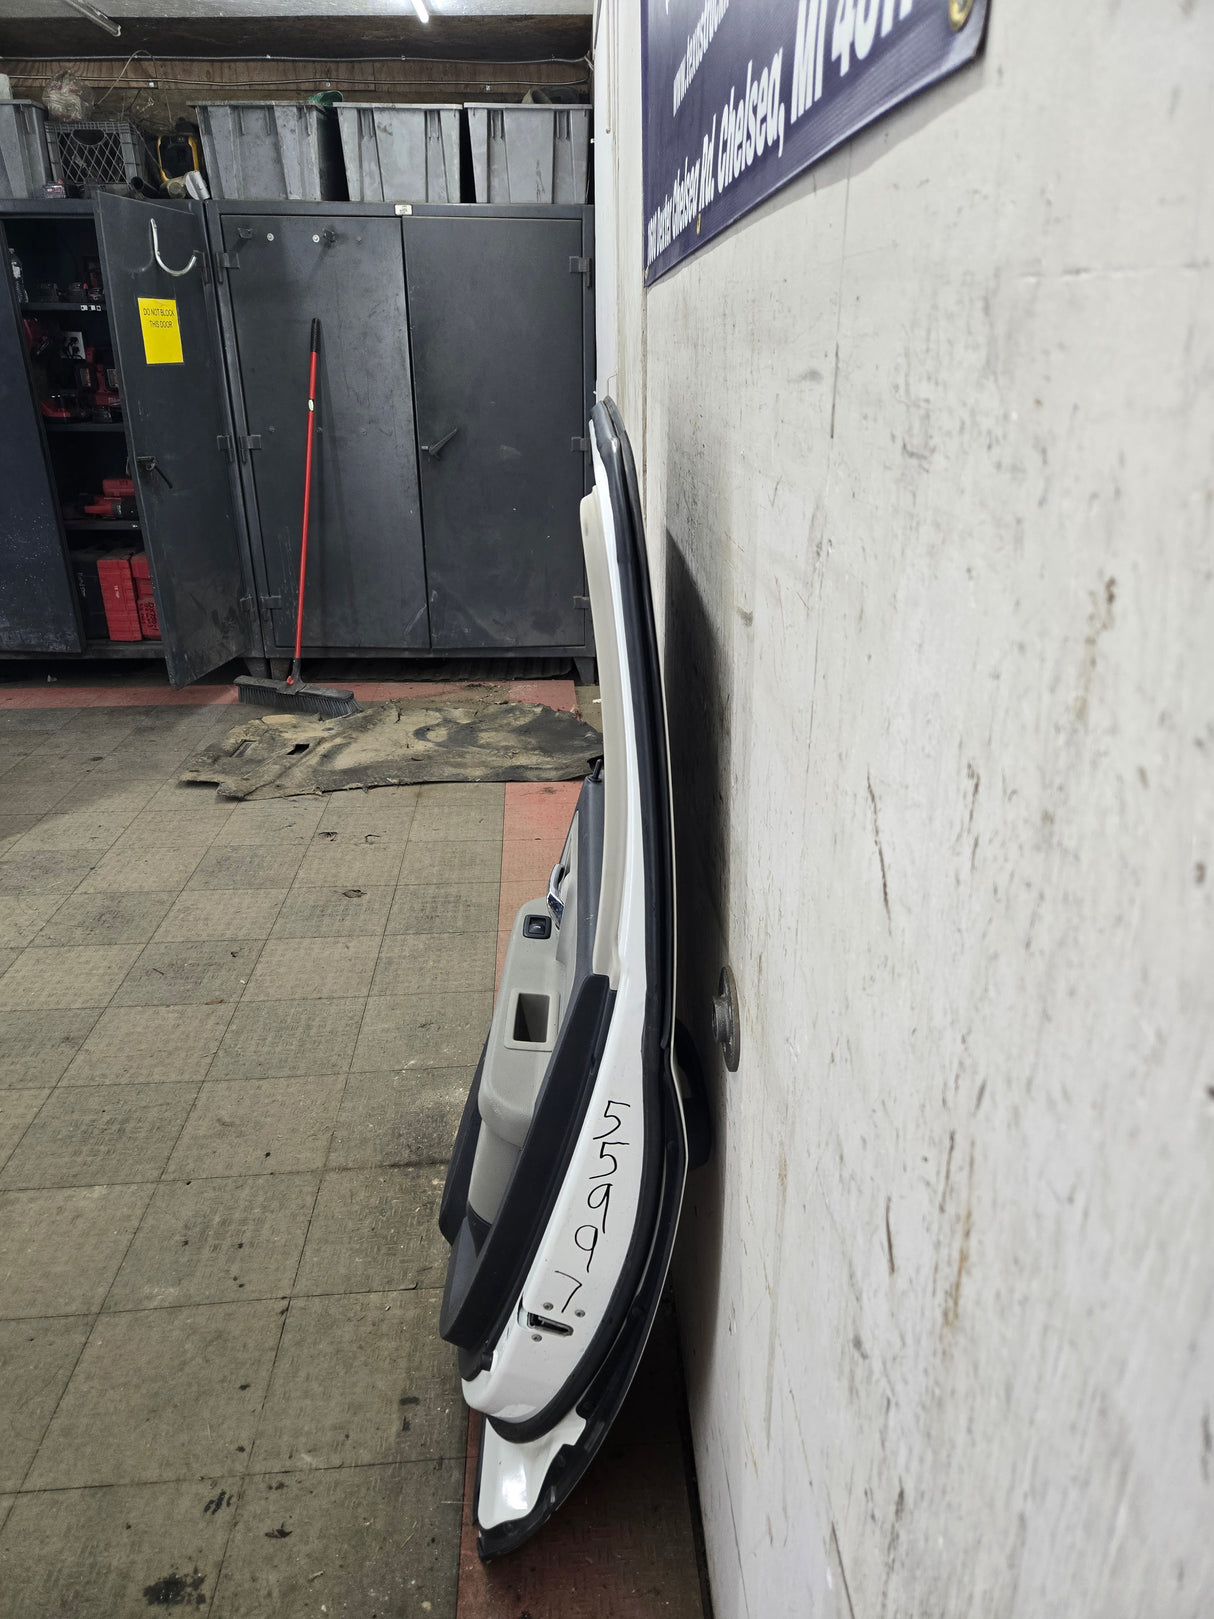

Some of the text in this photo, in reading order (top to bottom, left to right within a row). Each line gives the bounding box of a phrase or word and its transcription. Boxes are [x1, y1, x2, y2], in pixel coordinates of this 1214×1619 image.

[672, 156, 701, 240] Chelsea
[698, 113, 717, 212] Rd.
[717, 46, 785, 193] Chelsea,
[143, 307, 175, 317] DO NOT BLOCK
[149, 320, 173, 329] THIS DOOR
[554, 1100, 631, 1313] 55997
